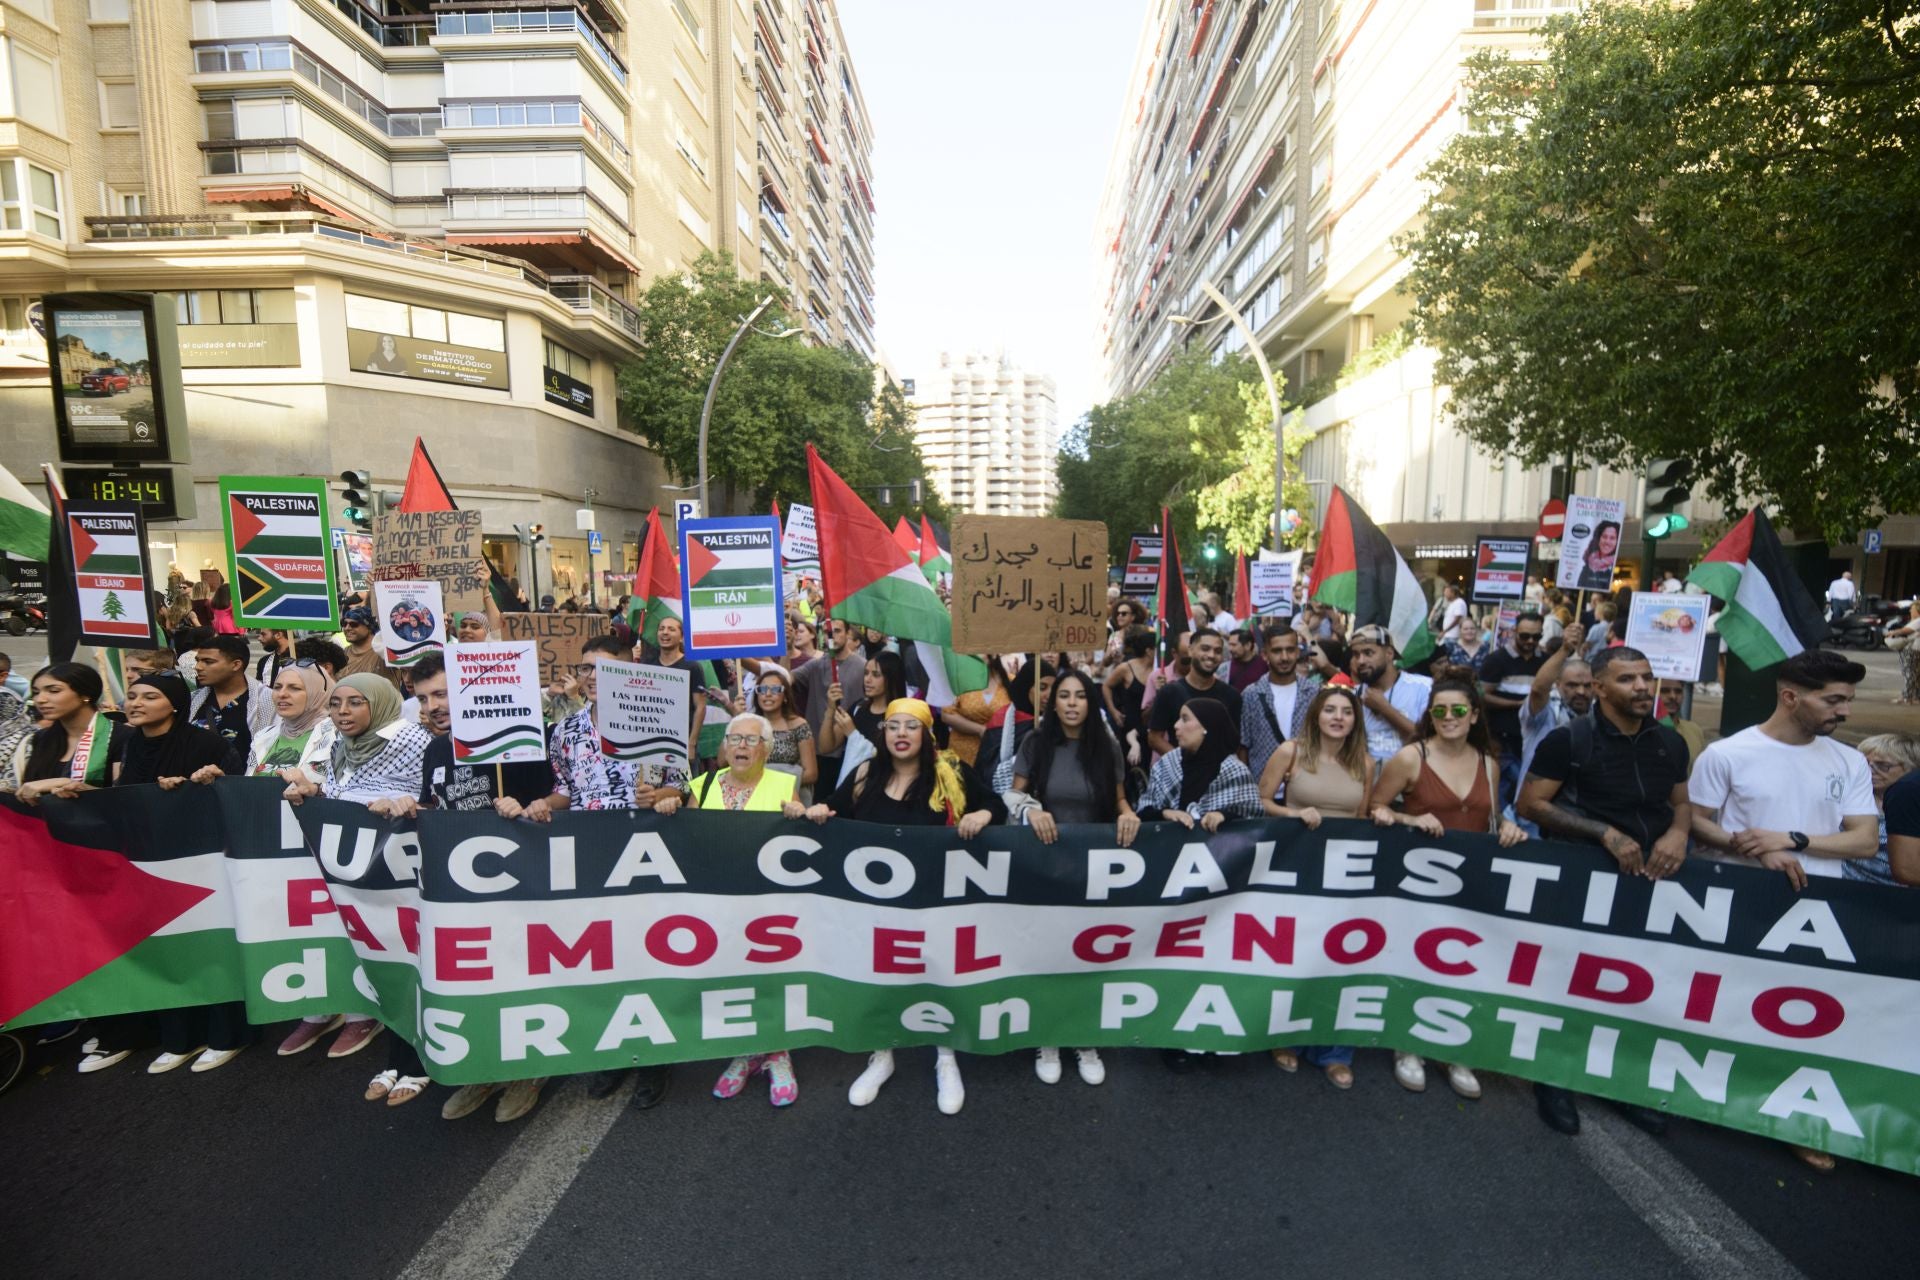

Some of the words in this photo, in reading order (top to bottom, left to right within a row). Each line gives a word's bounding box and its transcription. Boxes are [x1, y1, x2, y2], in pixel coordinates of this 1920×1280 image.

[415, 353, 492, 369] DERMATOLÓGICO
[433, 349, 475, 361] INSTITUTO
[92, 481, 160, 501] 18:44
[245, 497, 317, 511] PALESTINA
[679, 503, 693, 521] P
[1577, 510, 1615, 520] LIBERTAD
[81, 518, 135, 530] PALESTINA
[376, 515, 389, 533] IF
[427, 509, 482, 528] DESERVES
[375, 535, 388, 554] A
[389, 527, 448, 549] MOMENT
[454, 526, 475, 543] OF
[703, 534, 770, 547] PALESTINA
[1488, 542, 1527, 551] PALESTINA
[1869, 532, 1879, 550] P
[436, 543, 470, 559] THEN
[962, 532, 1039, 570] مجدك
[1415, 549, 1468, 558] STARBUCKS
[273, 562, 324, 573] SUDÁFRICA
[95, 577, 126, 588] LÍBANO
[1488, 572, 1510, 581] IRAK
[714, 589, 747, 604] IRÁN
[1066, 625, 1097, 644] BDS
[456, 650, 522, 662] DEMOLICIÓN
[462, 664, 516, 674] VIVIENDAS
[601, 664, 634, 676] TIERRA
[636, 669, 685, 683] PALESTINA
[460, 675, 522, 686] PALESTINAS
[628, 677, 654, 687] 2024
[473, 694, 514, 705] ISRAEL
[612, 691, 630, 701] LAS
[633, 693, 676, 706] TIERRAS
[462, 707, 532, 719] APARTHEID
[618, 702, 667, 715] ROBADAS
[608, 721, 680, 737] RECUPERADAS
[453, 765, 473, 781] NO
[446, 775, 491, 802] SOMOS
[455, 793, 492, 811] NADA
[757, 835, 1011, 899] CON
[1086, 839, 1857, 963] PALESTINA
[873, 925, 1002, 974] EL
[1072, 912, 1845, 1039] GENOCIDIO
[900, 997, 1031, 1040] en
[1100, 982, 1864, 1138] PALESTINA
